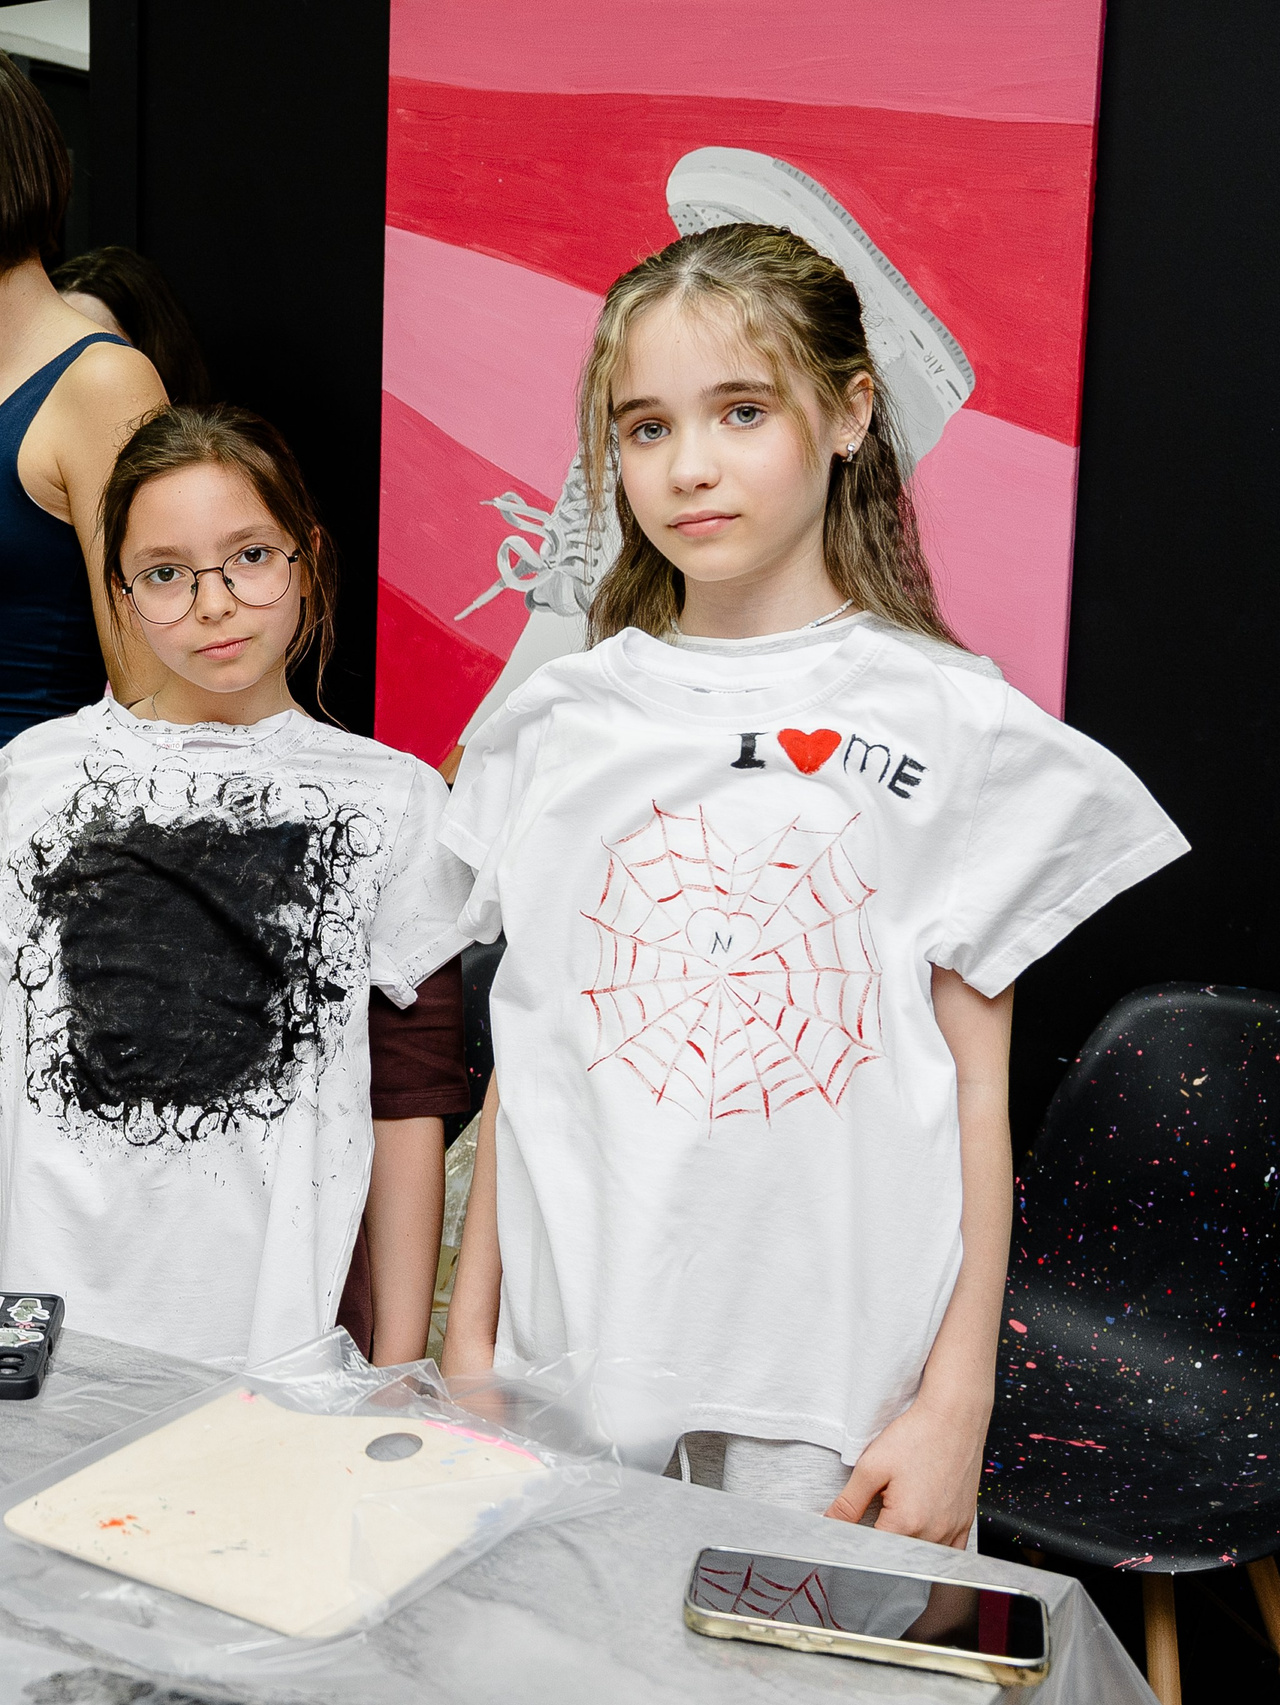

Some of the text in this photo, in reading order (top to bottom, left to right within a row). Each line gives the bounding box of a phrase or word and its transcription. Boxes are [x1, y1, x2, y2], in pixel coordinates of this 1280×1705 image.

[923, 350, 946, 375] AIR
[156, 742, 181, 750] ONITO
[728, 731, 769, 770] I
[710, 931, 734, 955] N
